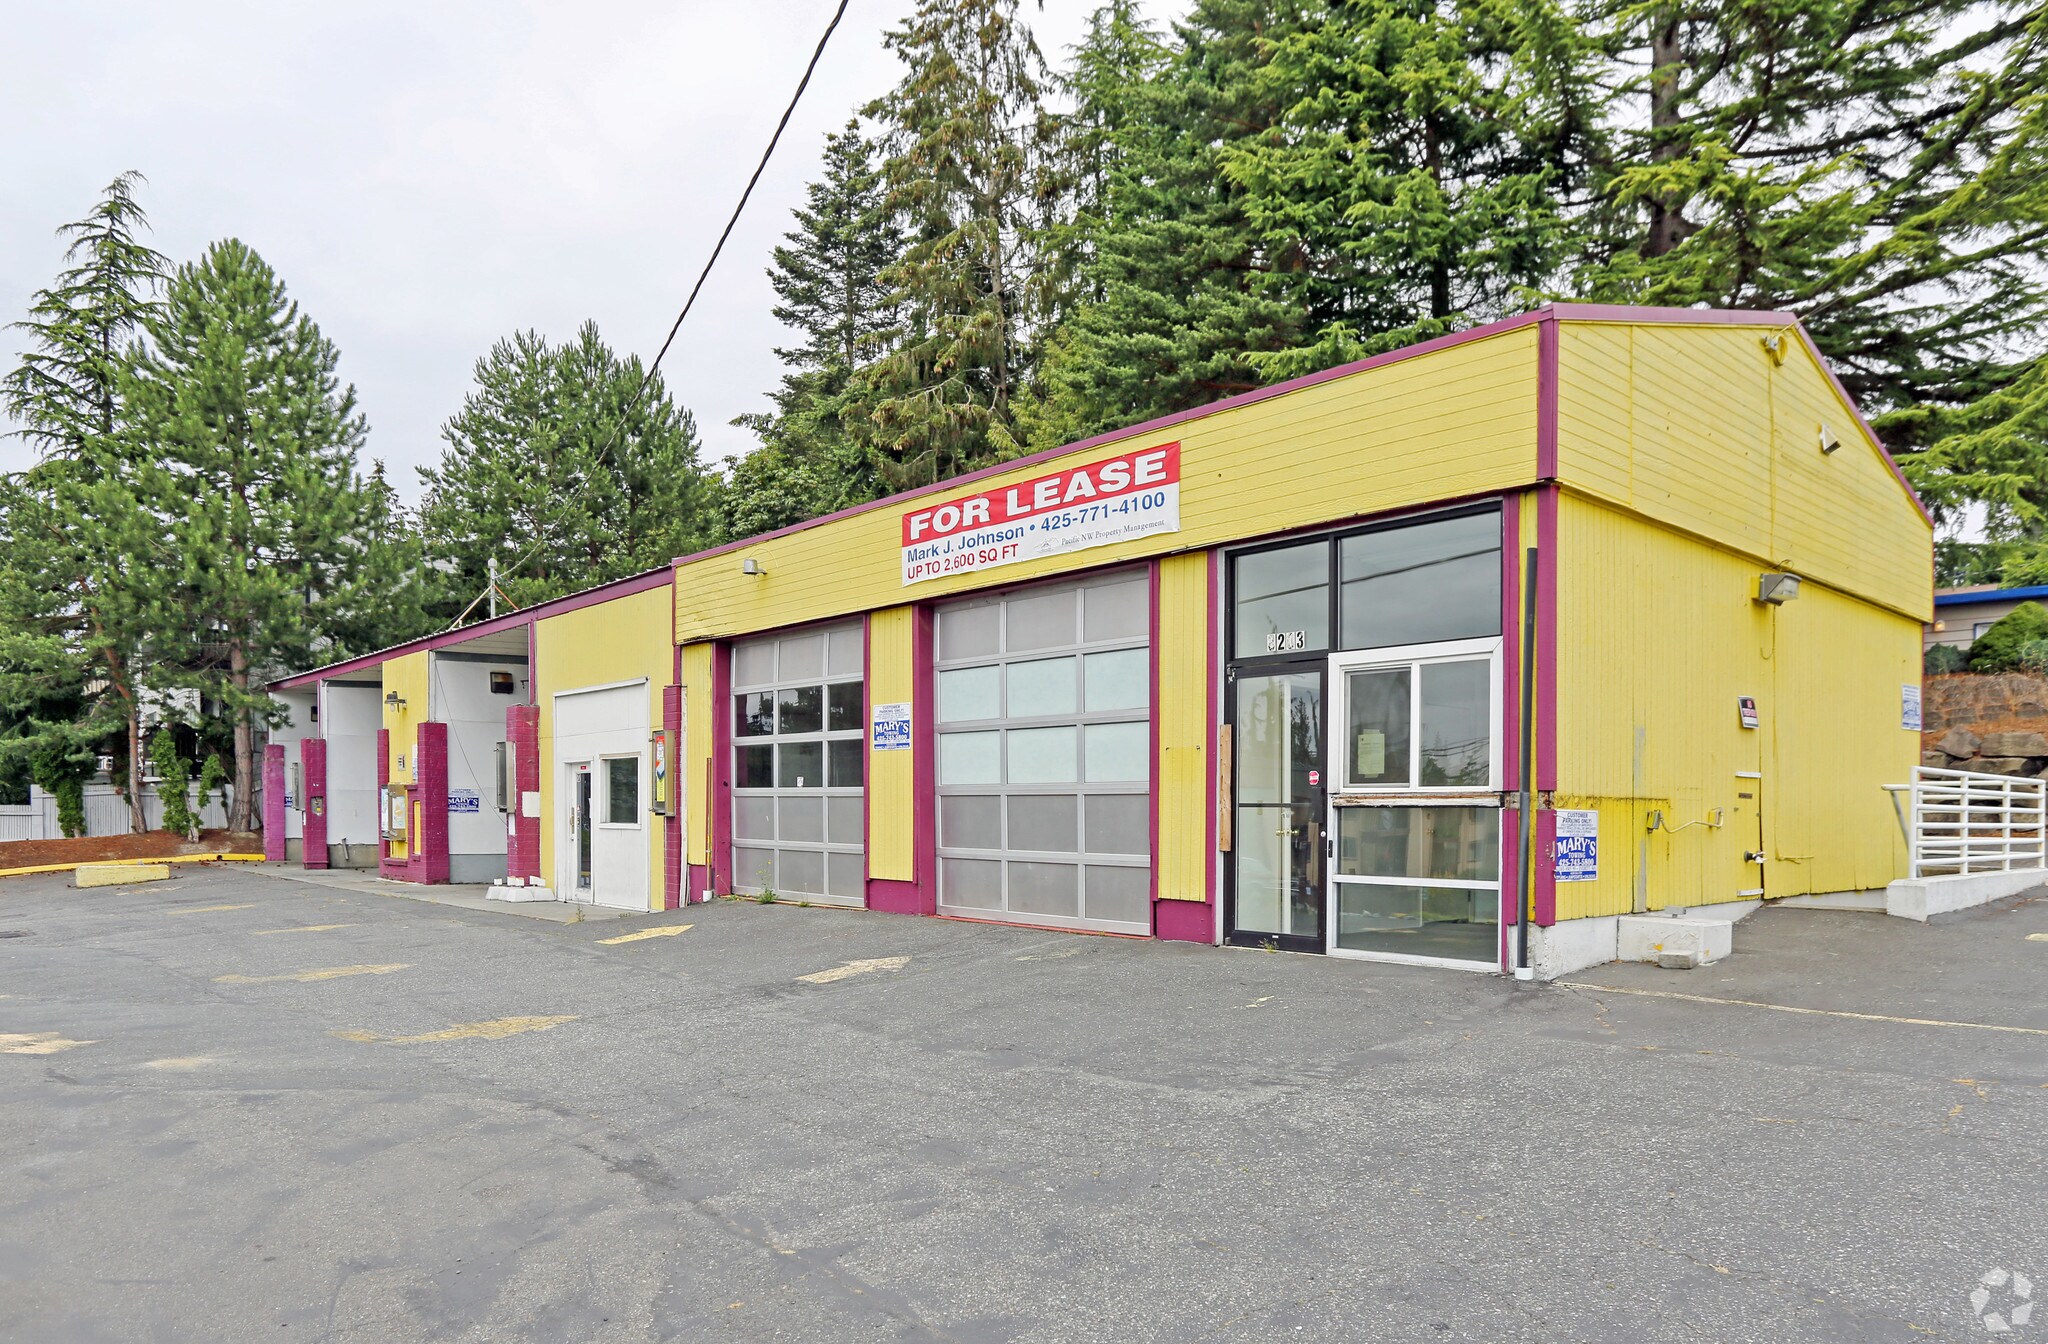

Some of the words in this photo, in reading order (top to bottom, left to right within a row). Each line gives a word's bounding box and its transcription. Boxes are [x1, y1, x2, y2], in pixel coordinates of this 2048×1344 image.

[910, 497, 991, 541] FOR
[1007, 450, 1167, 517] LEASE
[907, 544, 939, 563] Mark
[943, 540, 954, 555] J.
[958, 526, 1024, 550] Johnson
[1041, 492, 1165, 531] 425-771-4100
[1061, 536, 1080, 545] Pacific
[1081, 531, 1095, 541] NW
[1095, 528, 1122, 539] Property
[1123, 519, 1165, 533] Management
[907, 565, 923, 579] UP
[925, 560, 941, 575] TO
[944, 552, 975, 572] 2,600
[979, 548, 998, 564] SQ
[1002, 543, 1019, 559] FT
[875, 720, 909, 735] MARY'S
[449, 797, 478, 805] MARY'S
[1557, 837, 1596, 857] MARY'S
